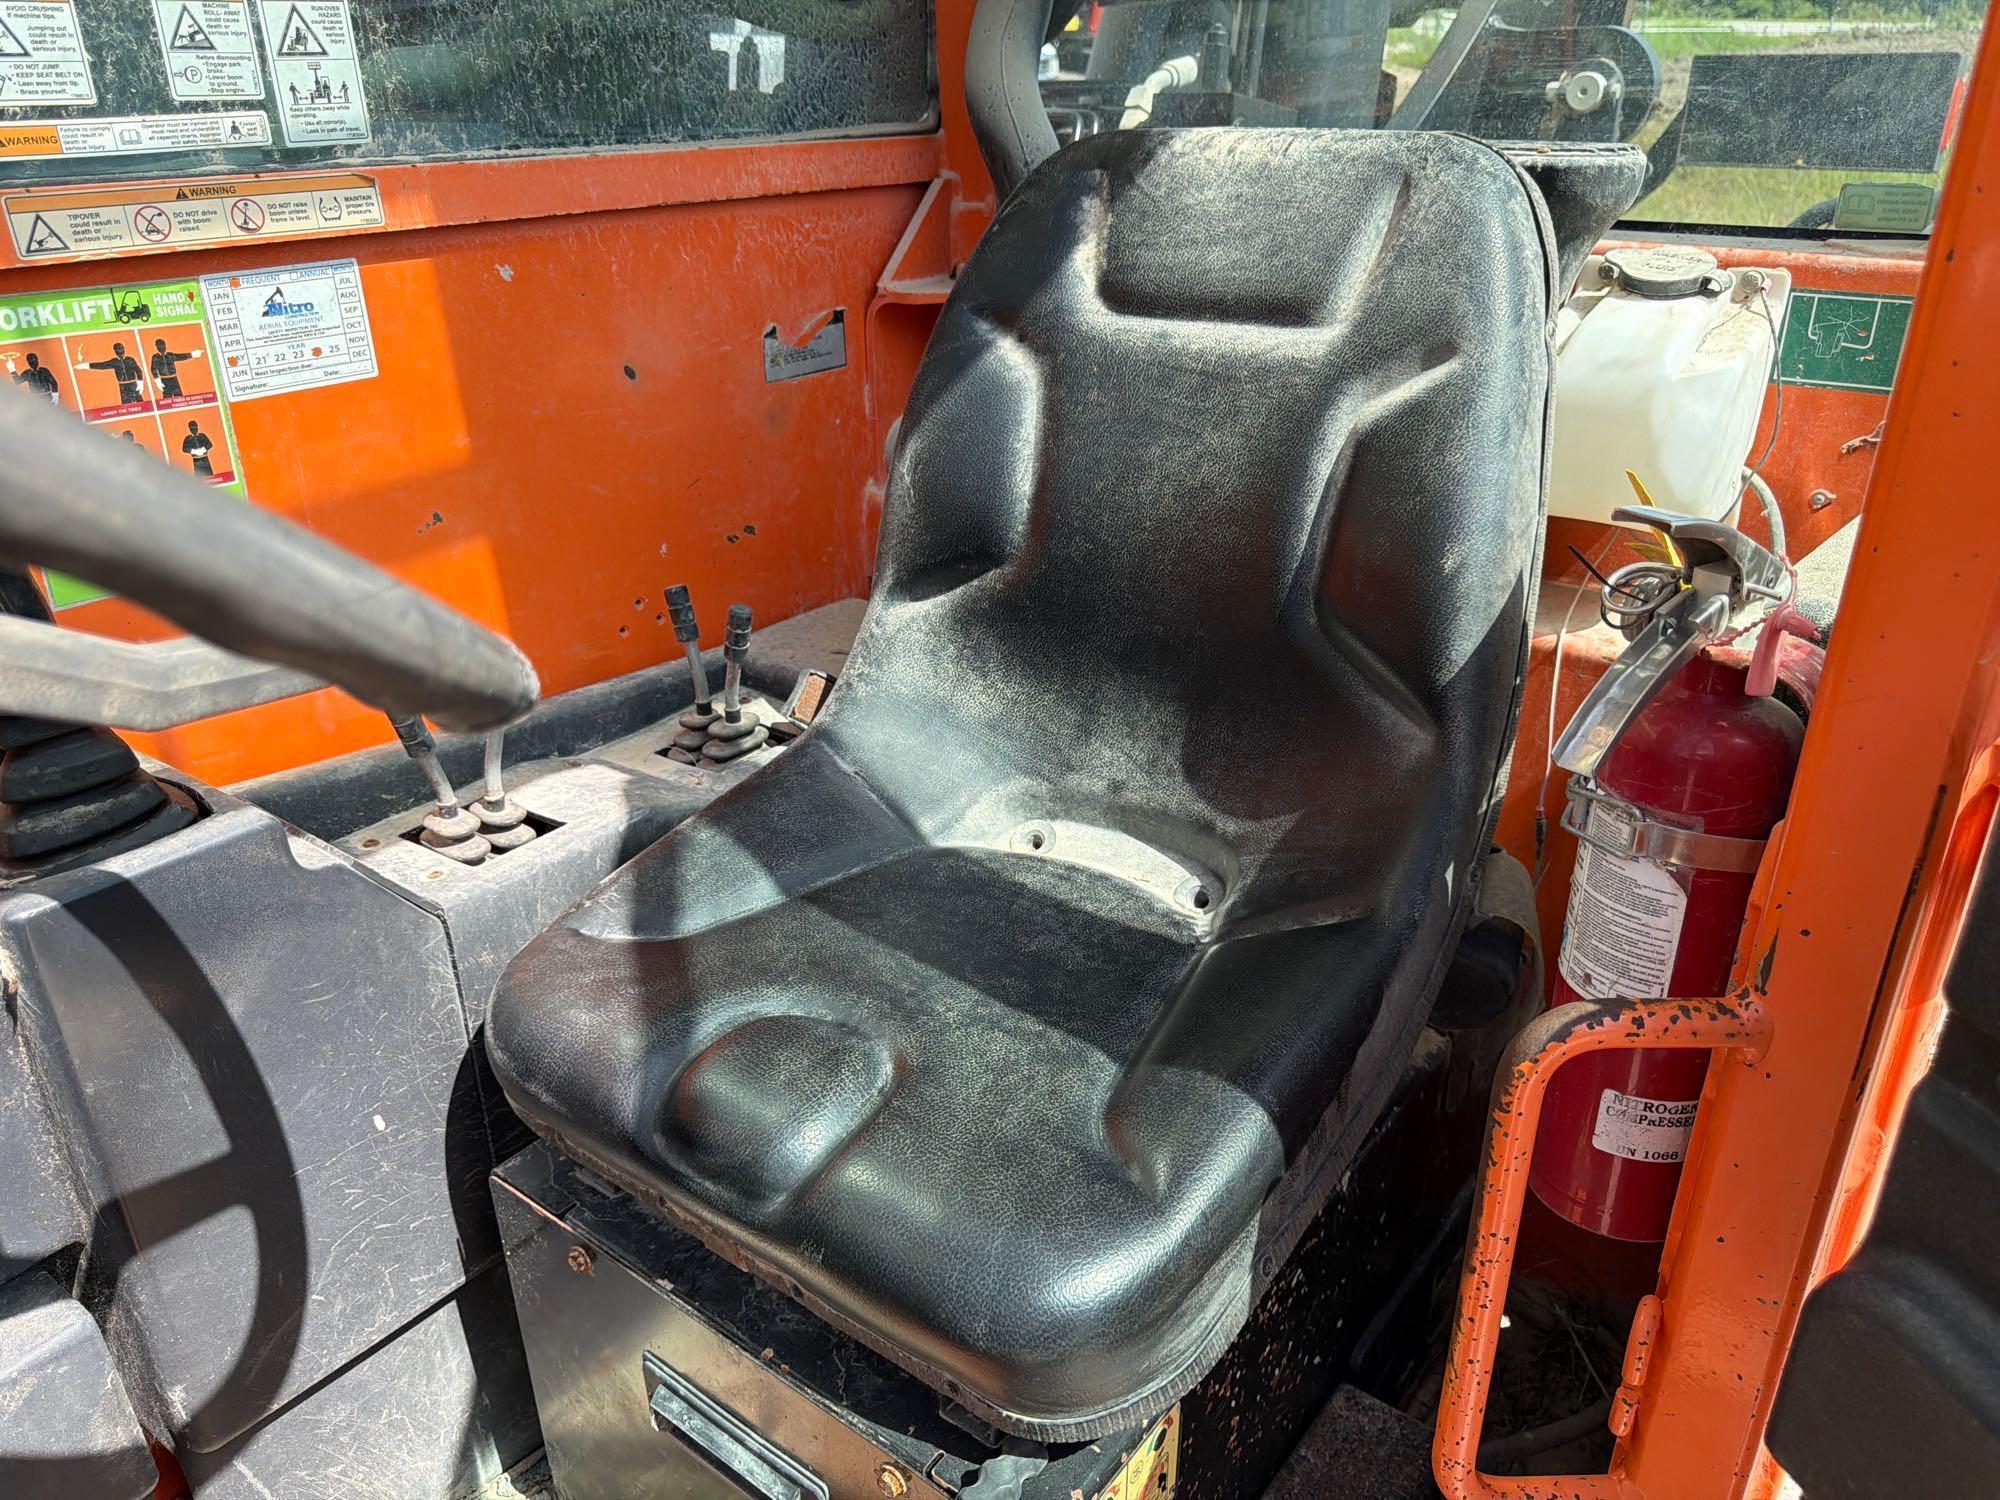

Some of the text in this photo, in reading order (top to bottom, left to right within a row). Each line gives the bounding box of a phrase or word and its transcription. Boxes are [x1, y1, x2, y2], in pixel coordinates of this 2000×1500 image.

[4, 135, 58, 147] WARNING
[188, 185, 237, 198] WARNING
[67, 212, 101, 221] TIPOVER
[173, 209, 218, 219] DO NOT drive
[70, 221, 90, 229] could
[92, 219, 112, 227] result
[74, 234, 124, 244] serious injury.
[299, 269, 330, 278] ANNUAL
[207, 279, 229, 287] MONTH
[241, 274, 281, 286] FREQUENT
[153, 292, 183, 305] HAND
[213, 293, 230, 301] JAN
[340, 291, 357, 299] AUG
[156, 305, 198, 317] SIGNAL
[217, 307, 233, 315] FEB
[268, 302, 315, 317] Nitro
[219, 323, 239, 332] MAR
[259, 316, 324, 331] AERIAL EQUIPMENT
[225, 339, 241, 348] APR
[230, 354, 245, 363] AY
[256, 345, 340, 365] 21 22 23 25
[352, 350, 368, 358] DEC
[232, 369, 248, 378] JUN
[270, 365, 300, 375] Inspection
[324, 369, 340, 377] Date:
[235, 382, 269, 392] Signature:
[100, 409, 118, 417] LOWER
[1613, 1094, 1699, 1115] NITROGEN
[1643, 1150, 1679, 1161] 1066
